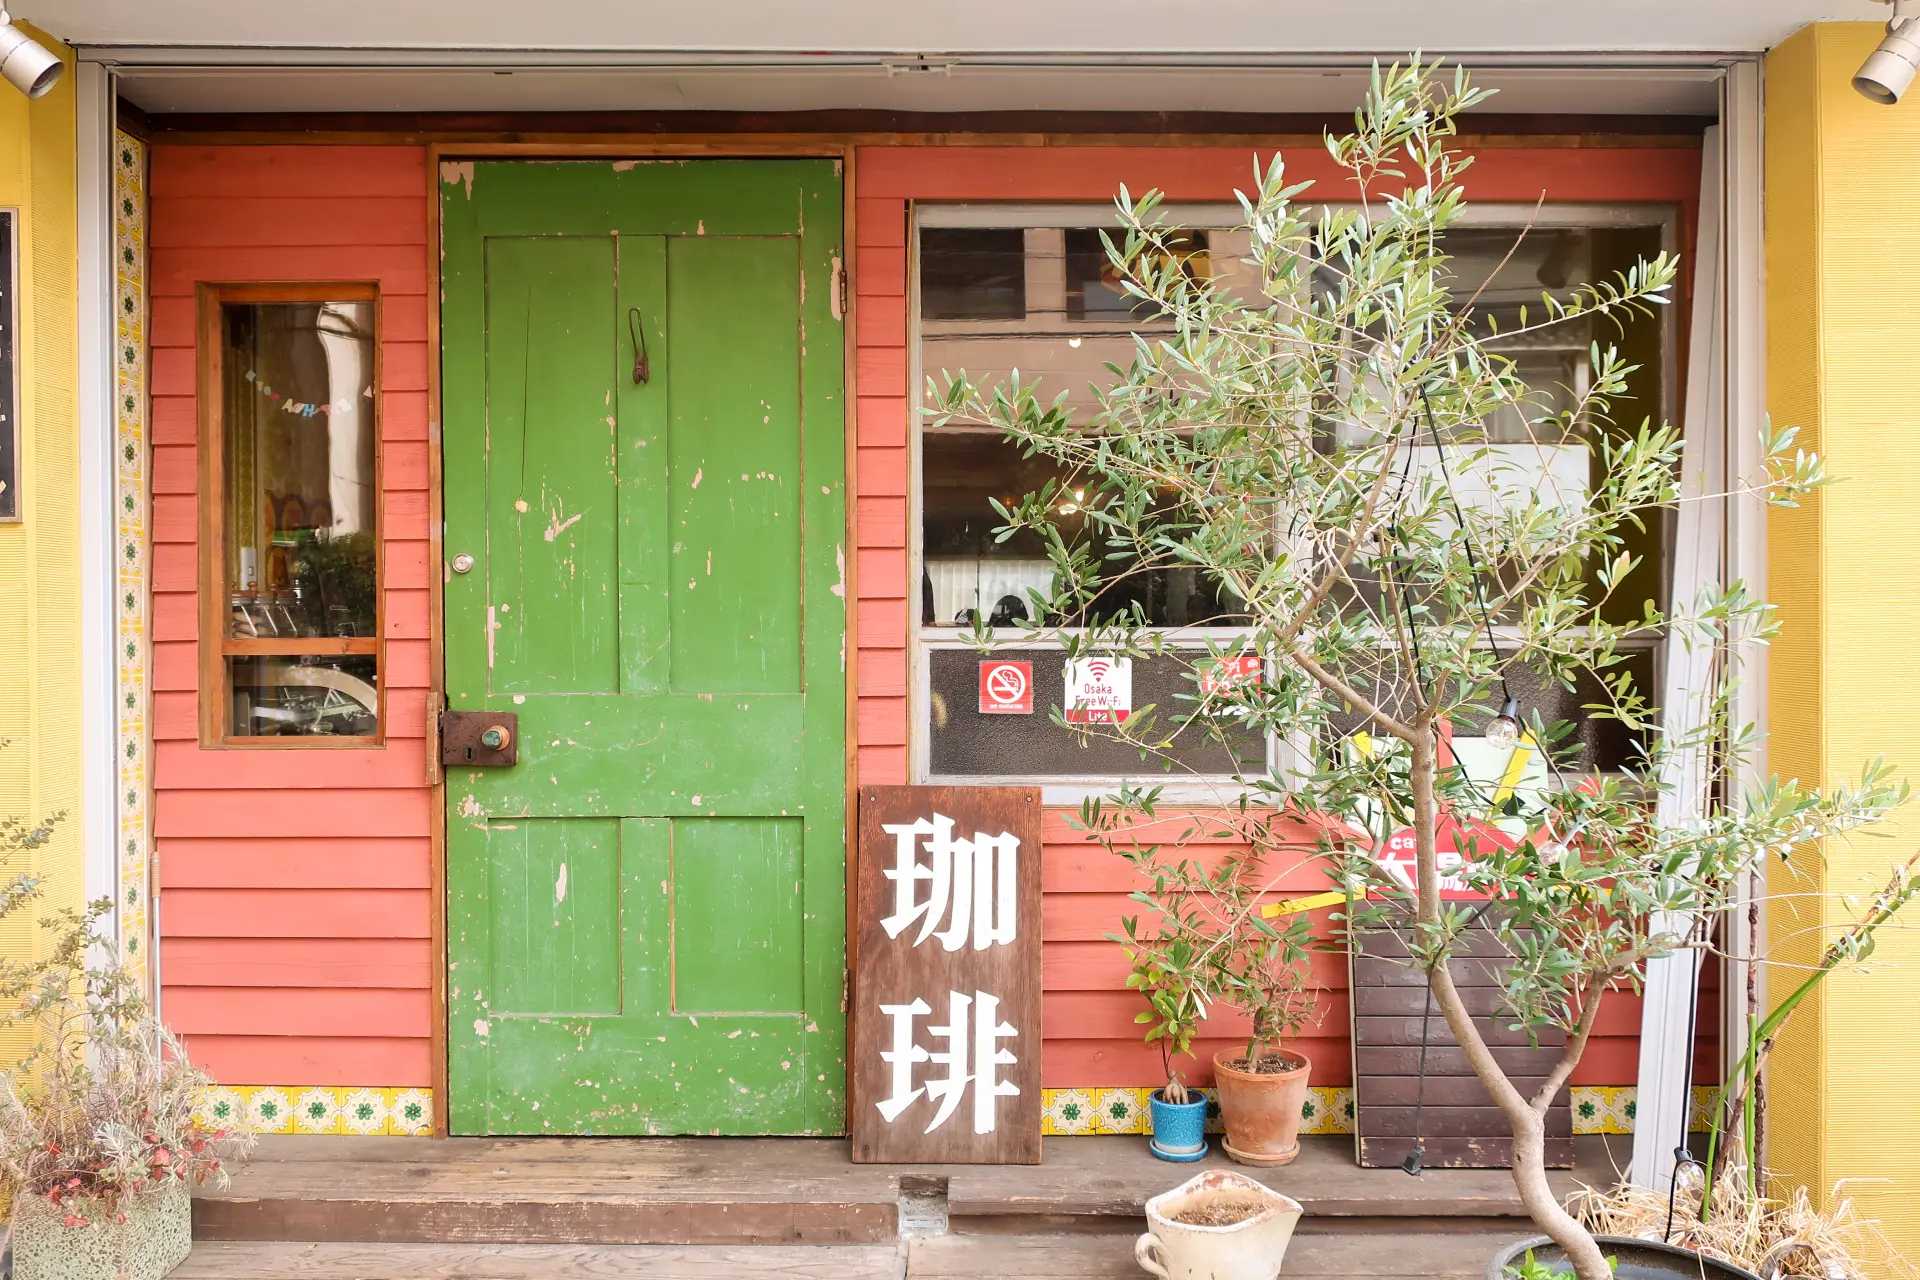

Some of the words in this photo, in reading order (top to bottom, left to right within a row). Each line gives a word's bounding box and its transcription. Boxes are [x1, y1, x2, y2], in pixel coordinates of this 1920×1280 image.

[1084, 683, 1112, 694] Osaka
[1075, 695, 1096, 706] Free
[1097, 695, 1121, 706] Wi-Fi
[1088, 710, 1108, 721] Lite
[875, 811, 1021, 1135] 珈琲
